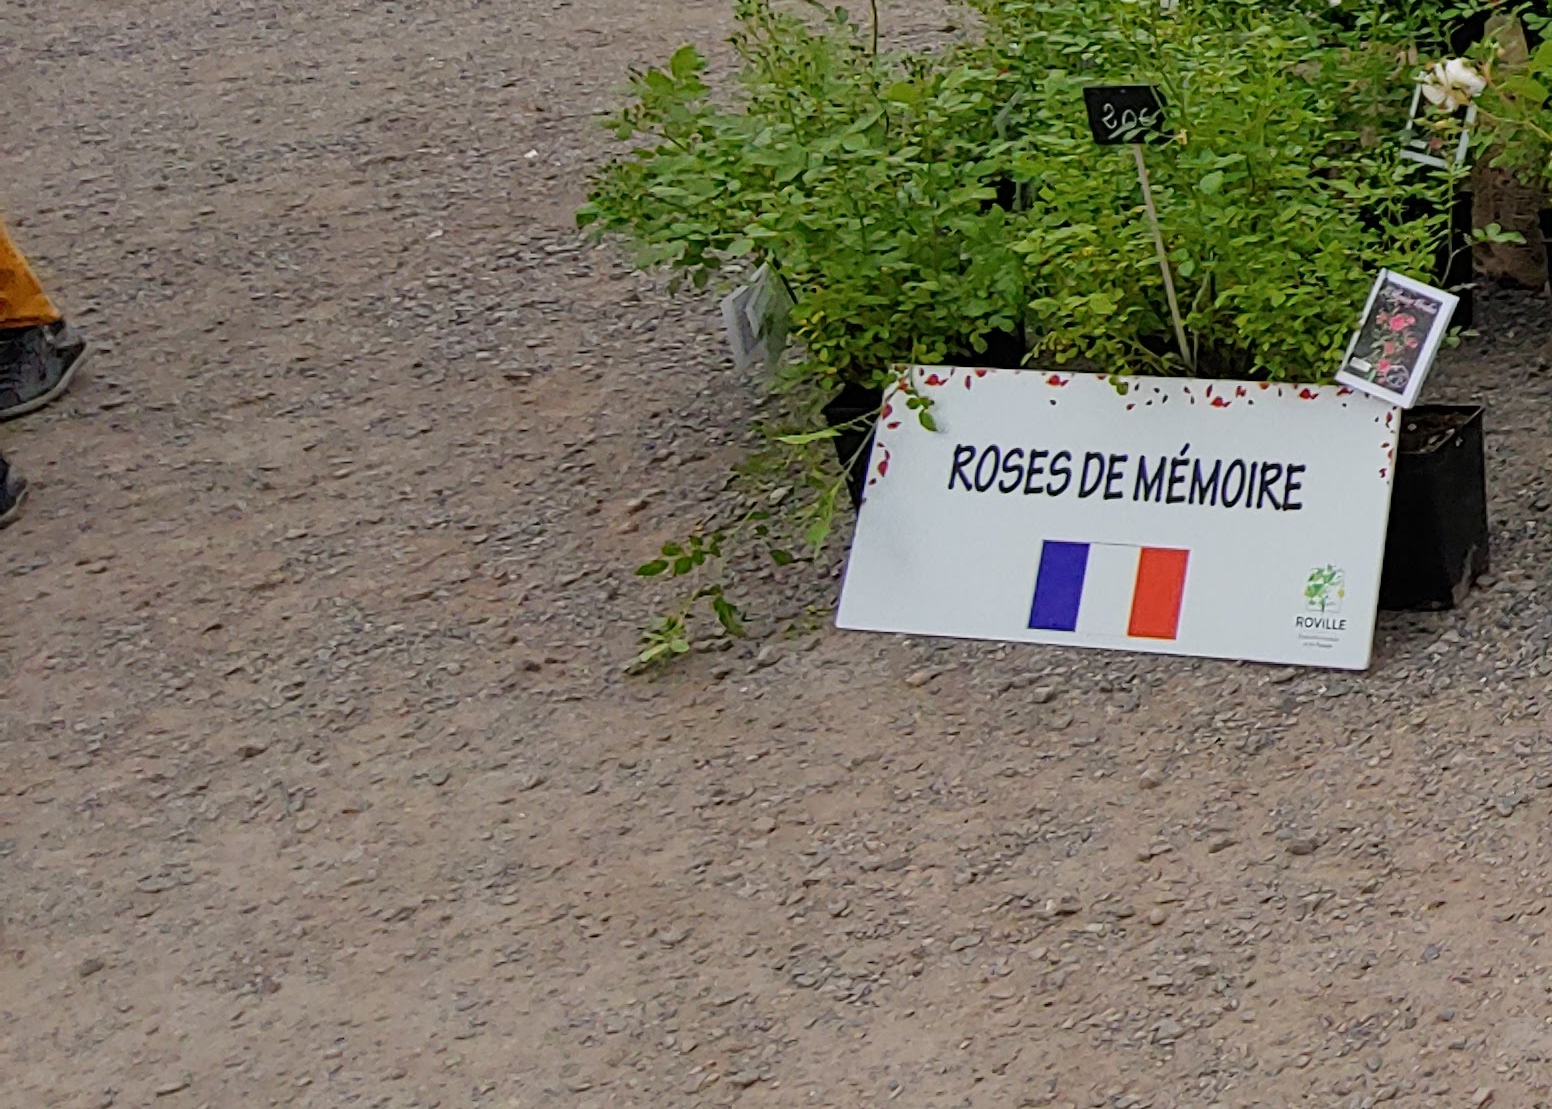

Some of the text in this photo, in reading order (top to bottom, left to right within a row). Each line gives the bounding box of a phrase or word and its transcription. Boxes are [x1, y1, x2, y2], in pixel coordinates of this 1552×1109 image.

[947, 443, 1306, 511] ROSES DE MÉMOIRE
[1295, 616, 1347, 631] ROVILLE
